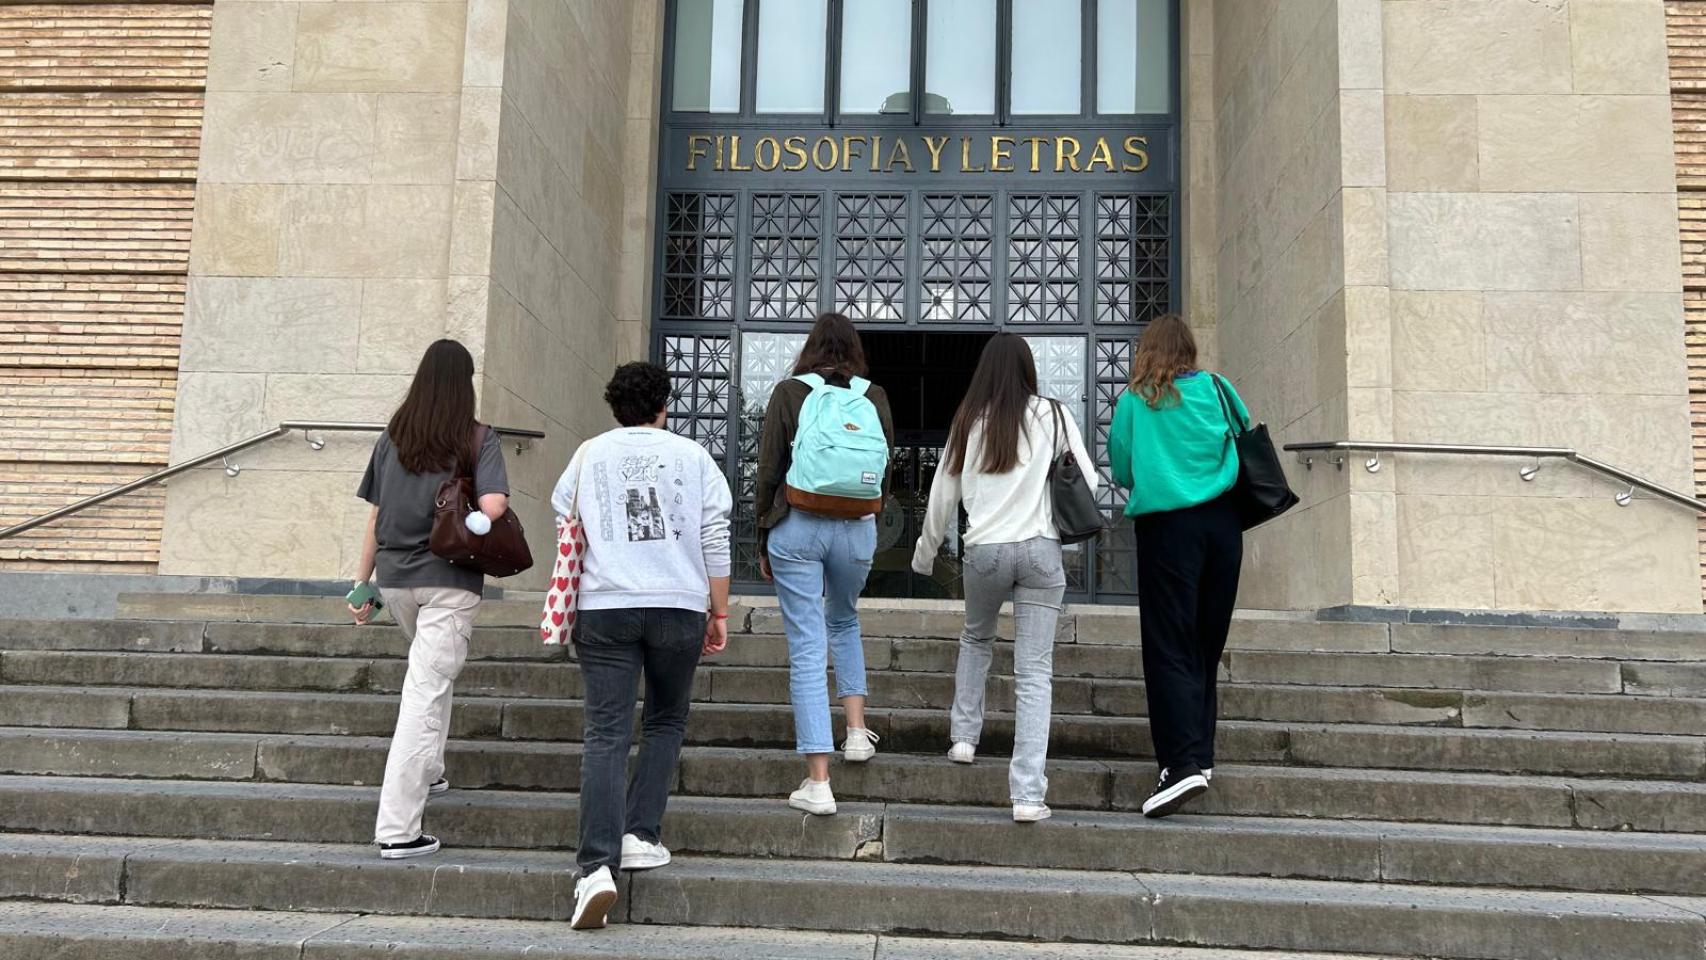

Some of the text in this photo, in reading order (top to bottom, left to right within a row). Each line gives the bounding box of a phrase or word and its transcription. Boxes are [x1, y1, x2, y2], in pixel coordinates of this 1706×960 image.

[686, 135, 1150, 173] FILOSOFIA Y LETRAS
